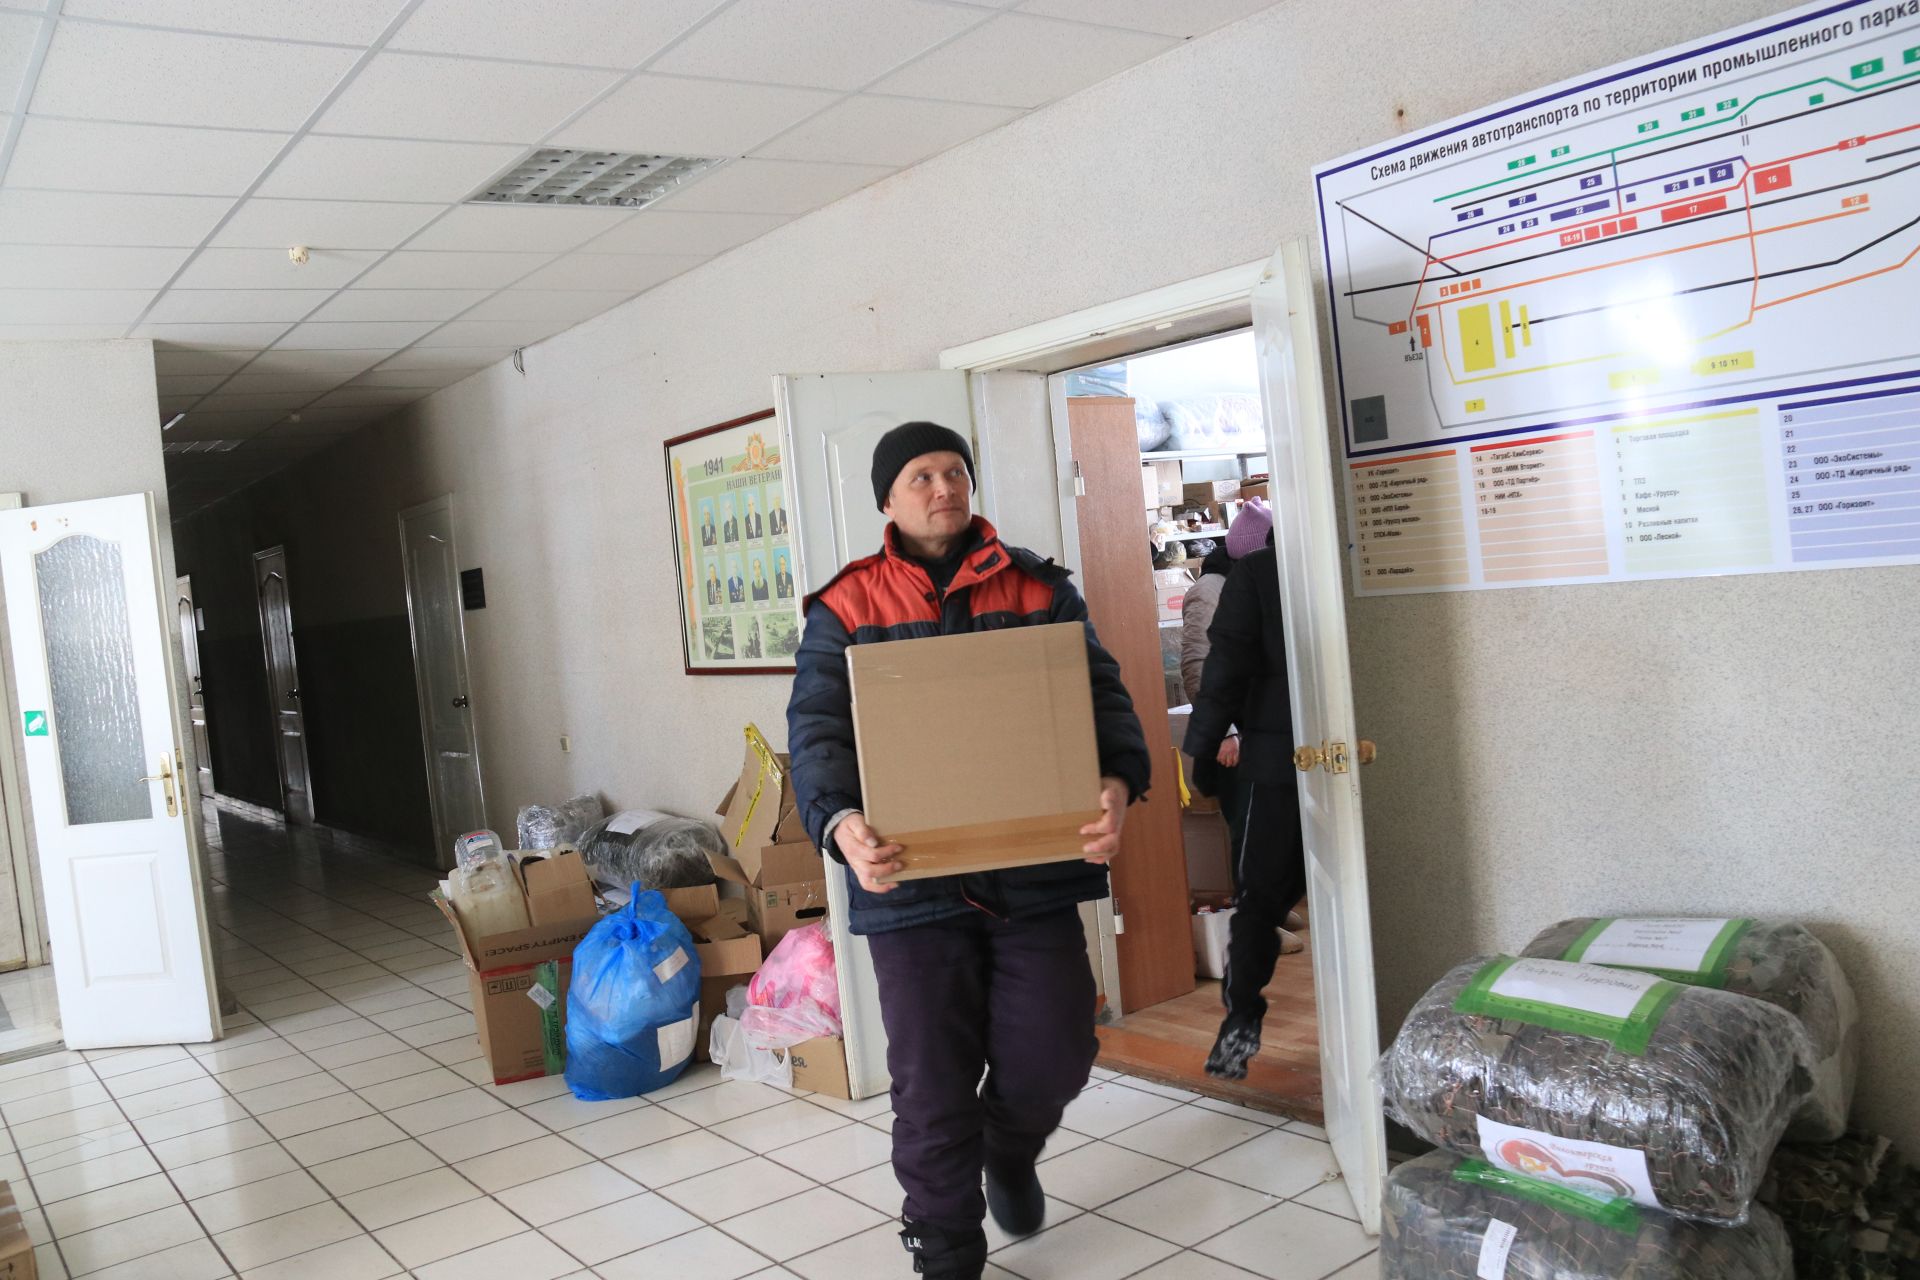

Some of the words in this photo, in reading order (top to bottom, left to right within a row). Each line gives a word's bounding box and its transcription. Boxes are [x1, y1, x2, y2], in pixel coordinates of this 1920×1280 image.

[1370, 159, 1406, 181] Схема
[1410, 138, 1468, 170] движения
[1472, 103, 1579, 148] автотранспорта
[1584, 97, 1600, 113] по
[1605, 68, 1697, 109] территории
[1703, 22, 1853, 80] промышленного
[1860, 0, 1919, 30] парка
[1847, 138, 1858, 147] 15
[1716, 168, 1727, 178] 20
[1767, 174, 1777, 184] 16
[1671, 182, 1681, 191] 21
[1575, 206, 1584, 215] 22
[1689, 205, 1698, 214] 17
[1783, 414, 1793, 423] 20
[1785, 430, 1794, 438] 21
[1787, 445, 1796, 453] 22
[1813, 456, 1829, 465] ООО
[703, 456, 724, 476] 1941
[1815, 471, 1830, 480] ООО
[1832, 469, 1846, 479] «ТД
[726, 476, 748, 490] НАШИ
[749, 470, 782, 486] ВЕТЕРАН
[1818, 502, 1833, 511] ООО
[1639, 534, 1652, 542] ООО
[532, 935, 576, 948] EMPTY
[485, 943, 530, 956] SPACE!
